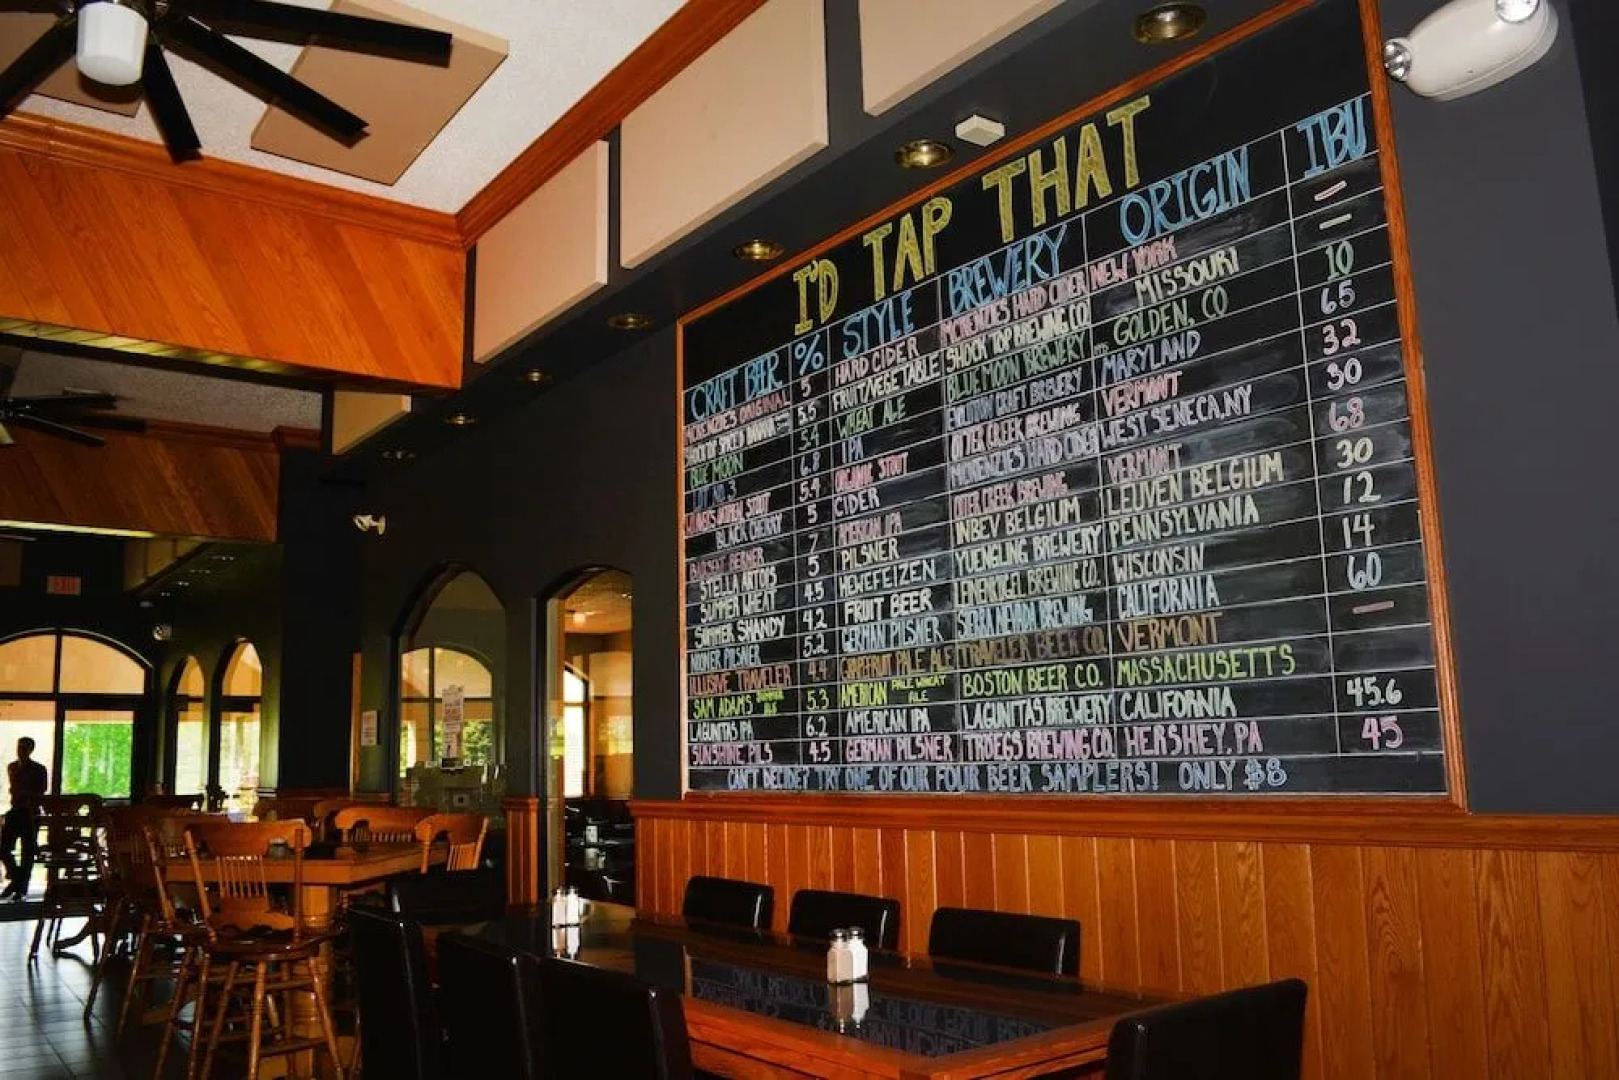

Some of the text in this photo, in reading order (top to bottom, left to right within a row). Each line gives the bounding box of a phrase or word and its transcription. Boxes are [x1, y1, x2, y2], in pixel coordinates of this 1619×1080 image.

[1297, 97, 1367, 179] IBU
[1120, 143, 1251, 247] ORIGIN
[793, 95, 1151, 335] I'D TAP THAT
[949, 222, 1068, 317] BREWERY
[1089, 236, 1176, 289] NEW YORK
[1135, 246, 1238, 305] MISSOURI
[1325, 241, 1353, 278] 10
[1320, 280, 1355, 314] 65
[843, 290, 915, 358] STYLE
[1113, 286, 1227, 345] GOLDEN, CO
[946, 308, 1068, 371] SHOCK TOP BREWING
[1322, 319, 1360, 353] 32
[794, 334, 825, 376] %
[835, 336, 918, 385] HARD CIDER
[946, 368, 980, 401] BLUE
[981, 355, 1020, 388] MOON
[1022, 333, 1083, 374] BREWERY
[1101, 330, 1200, 384] MARYLAND
[691, 352, 783, 419] CRAFT BEER
[800, 378, 811, 397] 5
[1327, 358, 1362, 389] 30
[1102, 371, 1180, 415] VERMONT
[837, 395, 905, 437] WHEAT ALE
[1102, 412, 1147, 445] WEST
[1328, 397, 1364, 430] 68
[712, 452, 743, 479] MOON
[841, 436, 863, 462] IPA
[1026, 437, 1062, 467] HARD
[1107, 443, 1182, 483] VERMONT
[1336, 437, 1373, 466] 30
[1106, 452, 1283, 515] LEUVEN BELGIUM
[1343, 472, 1381, 503] 12
[807, 504, 816, 523] 5
[834, 487, 879, 516] CIDER
[715, 523, 748, 548] BLACK
[956, 497, 1080, 543] INBEV BELGIUM
[1109, 495, 1258, 545] PENNSYLVANIA
[1342, 515, 1374, 547] 14
[809, 533, 818, 553] 7
[841, 538, 899, 569] PILSNER
[1032, 525, 1101, 561] BREWERY
[807, 554, 819, 576] 5
[1081, 559, 1101, 586] CO.
[1112, 542, 1203, 581] WISCONSIN
[1347, 552, 1381, 588] 60
[700, 566, 777, 600] STELLA ARTOIS
[1117, 575, 1218, 617] CALIFORNIA
[700, 587, 776, 622] SUMMER WHEAT
[844, 588, 932, 623] FRUIT BEER
[694, 615, 785, 647] SUMMER SHANDY
[802, 636, 828, 657] 5.2
[889, 616, 942, 646] PILSNER
[1037, 629, 1078, 658] BEER
[1117, 613, 1220, 650] VERMONT
[895, 645, 954, 674] PALE ALE
[1117, 645, 1294, 685] MASSACHUSETTS
[908, 690, 928, 701] ALE
[962, 663, 1103, 696] BOSTON BEER CO.
[1346, 678, 1401, 706] 45.6
[693, 695, 753, 719] SAM ADAMS
[806, 689, 829, 710] 5.3
[963, 694, 1110, 728] LAGUNITAS BREWERY
[1120, 688, 1235, 720] CALIFORNIA
[805, 717, 828, 736] 6.2
[846, 707, 930, 733] AMERICAN IPA
[1361, 717, 1402, 748] 45
[692, 742, 772, 764] SUNSHINE PILS
[809, 741, 830, 761] 4.5
[846, 736, 952, 760] GERMAN PILSNER
[963, 731, 1023, 759] TROEGS
[1026, 729, 1090, 758] BREWING
[1234, 722, 1262, 752] PA
[814, 766, 840, 788] TRY
[845, 766, 874, 789] ONE
[880, 766, 897, 789] OF
[899, 765, 929, 789] OUR
[935, 765, 979, 789] FOUR
[987, 764, 1032, 790] BEER
[1041, 762, 1157, 789] SAMPLERS!
[1178, 761, 1235, 788] ONLY
[1244, 758, 1286, 788] $8
